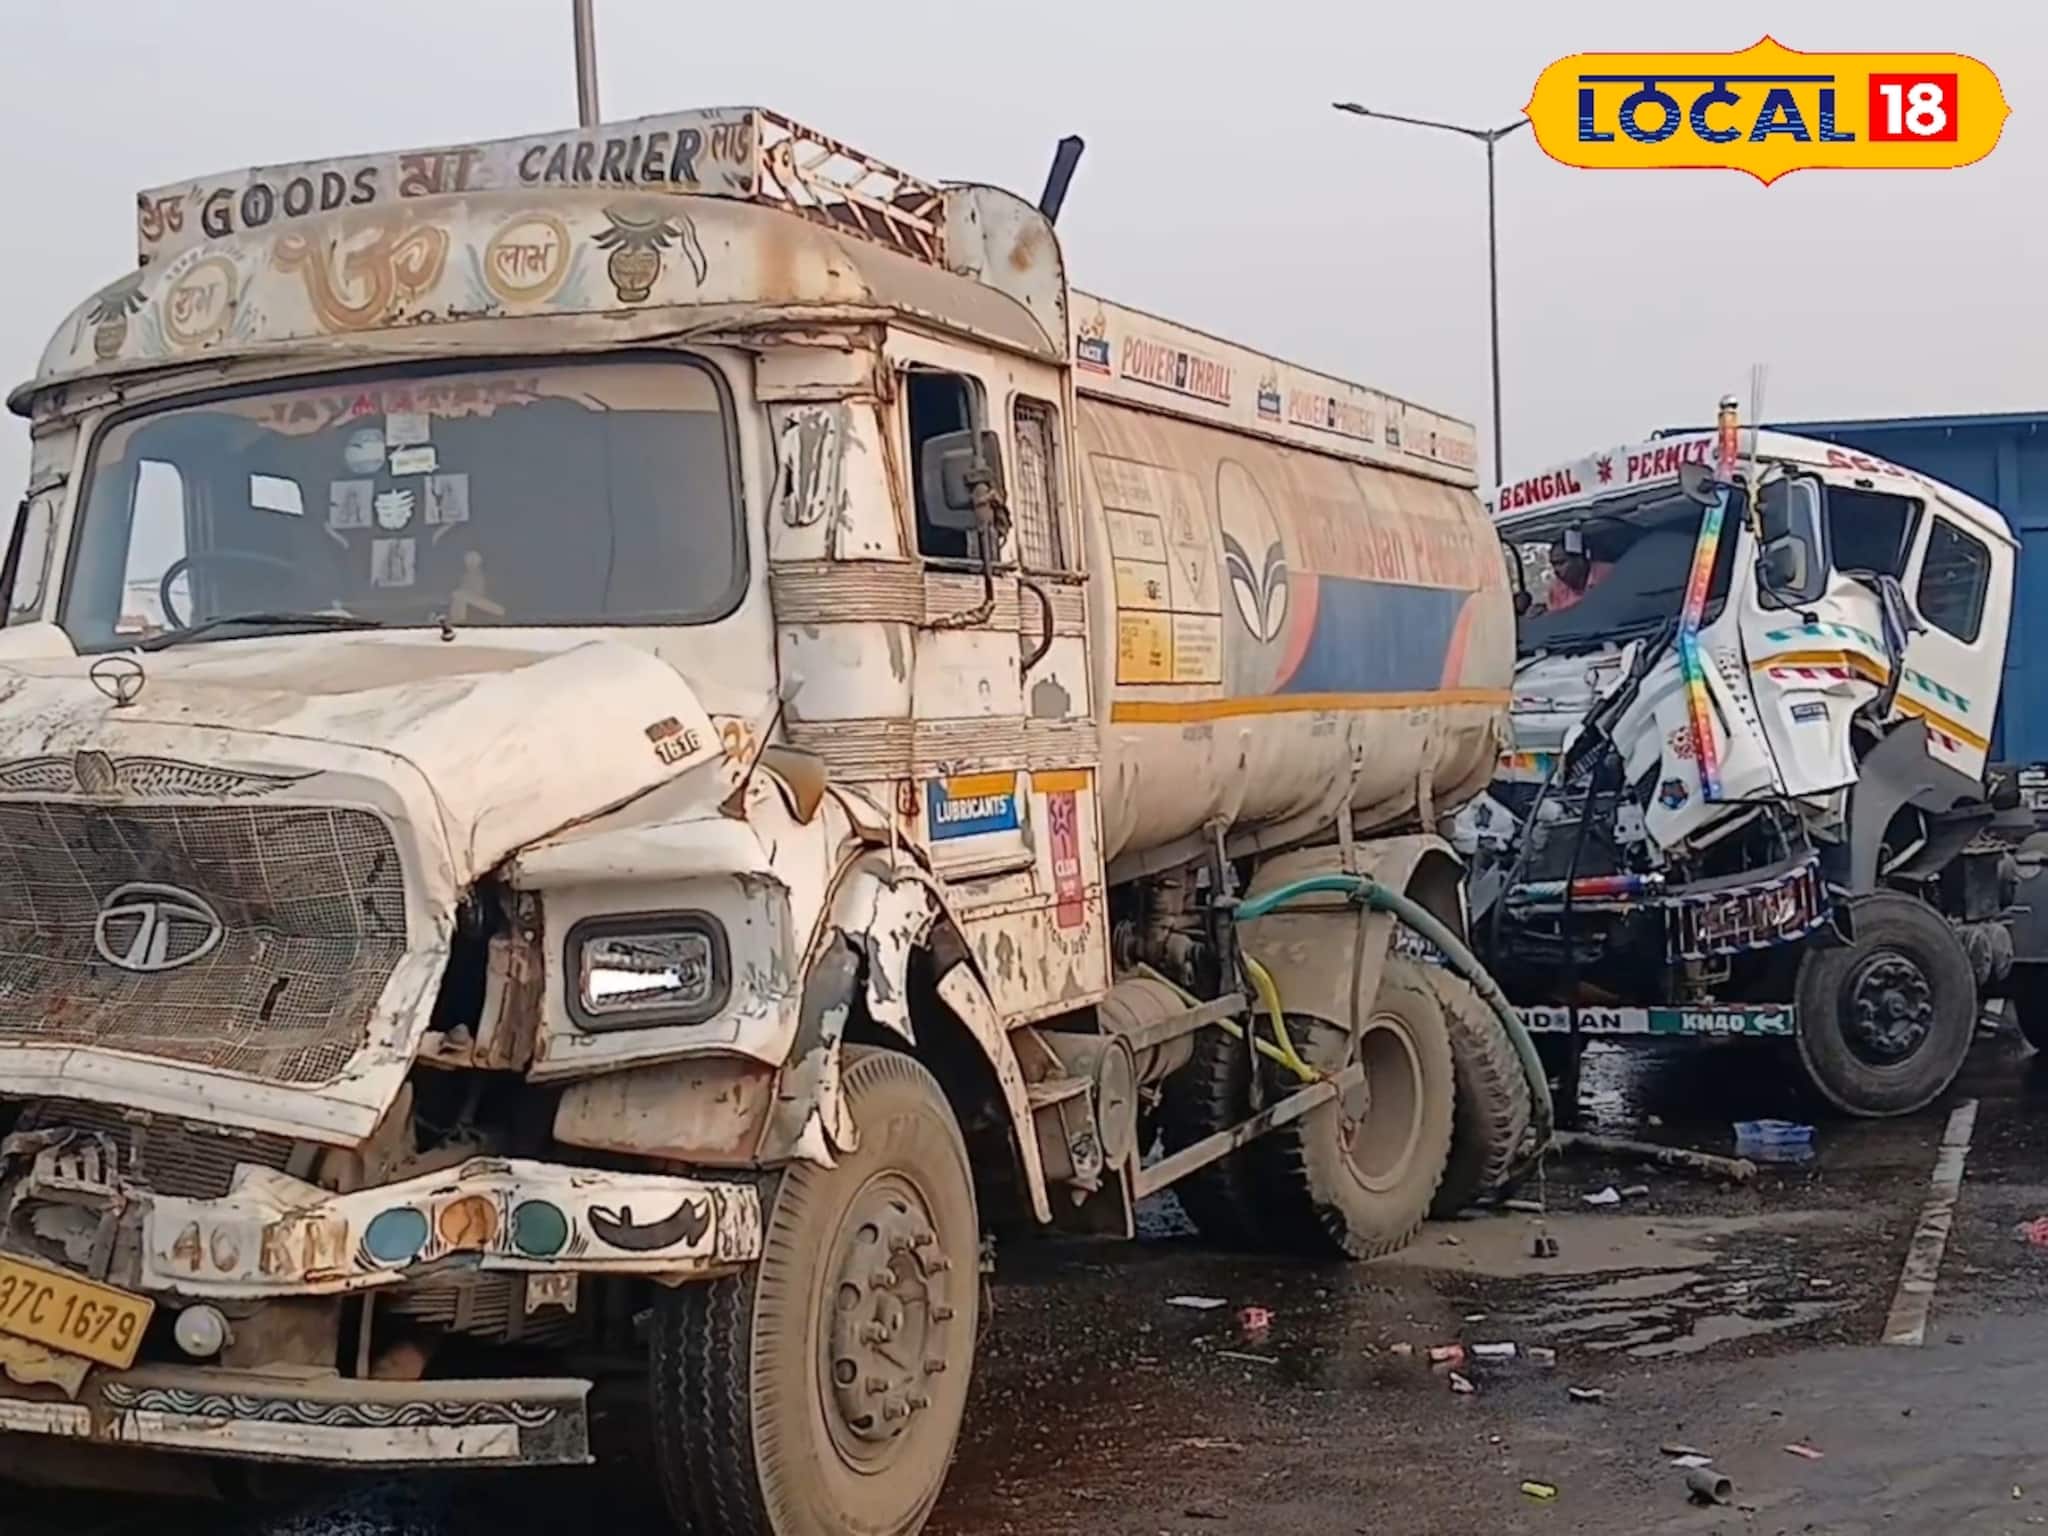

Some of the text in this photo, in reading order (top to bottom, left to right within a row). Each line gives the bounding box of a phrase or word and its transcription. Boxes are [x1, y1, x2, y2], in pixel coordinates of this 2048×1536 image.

[518, 129, 701, 183] CARRIER
[201, 167, 378, 239] GOODS
[1121, 335, 1176, 385] POWER
[1188, 356, 1232, 399] THRILL
[1500, 439, 1713, 512] BENGAL PERMIT
[935, 794, 1008, 823] LUBRICANTS
[259, 1213, 349, 1275] KM
[58, 1294, 136, 1351] 1679
